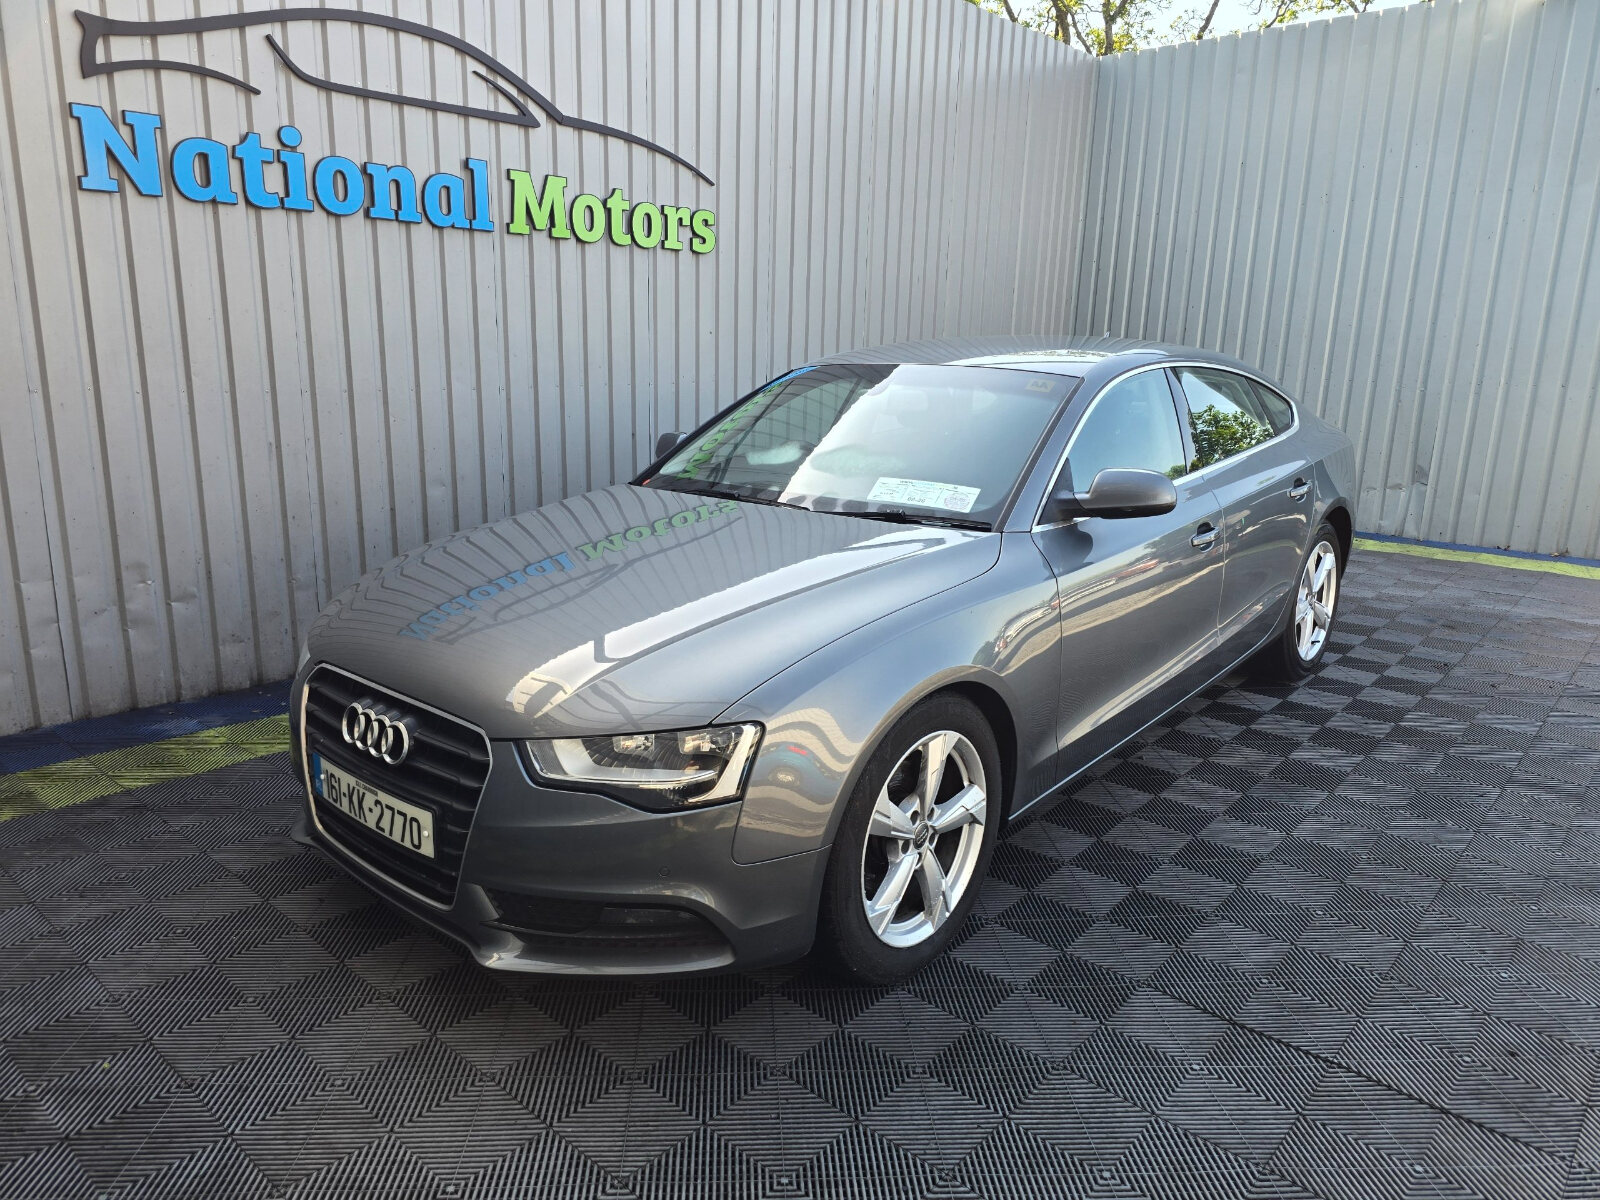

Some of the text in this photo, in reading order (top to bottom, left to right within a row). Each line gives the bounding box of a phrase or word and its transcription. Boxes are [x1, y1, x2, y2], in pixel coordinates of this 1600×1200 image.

[70, 102, 716, 254] National Motors
[324, 769, 422, 851] 161-KK-2770
